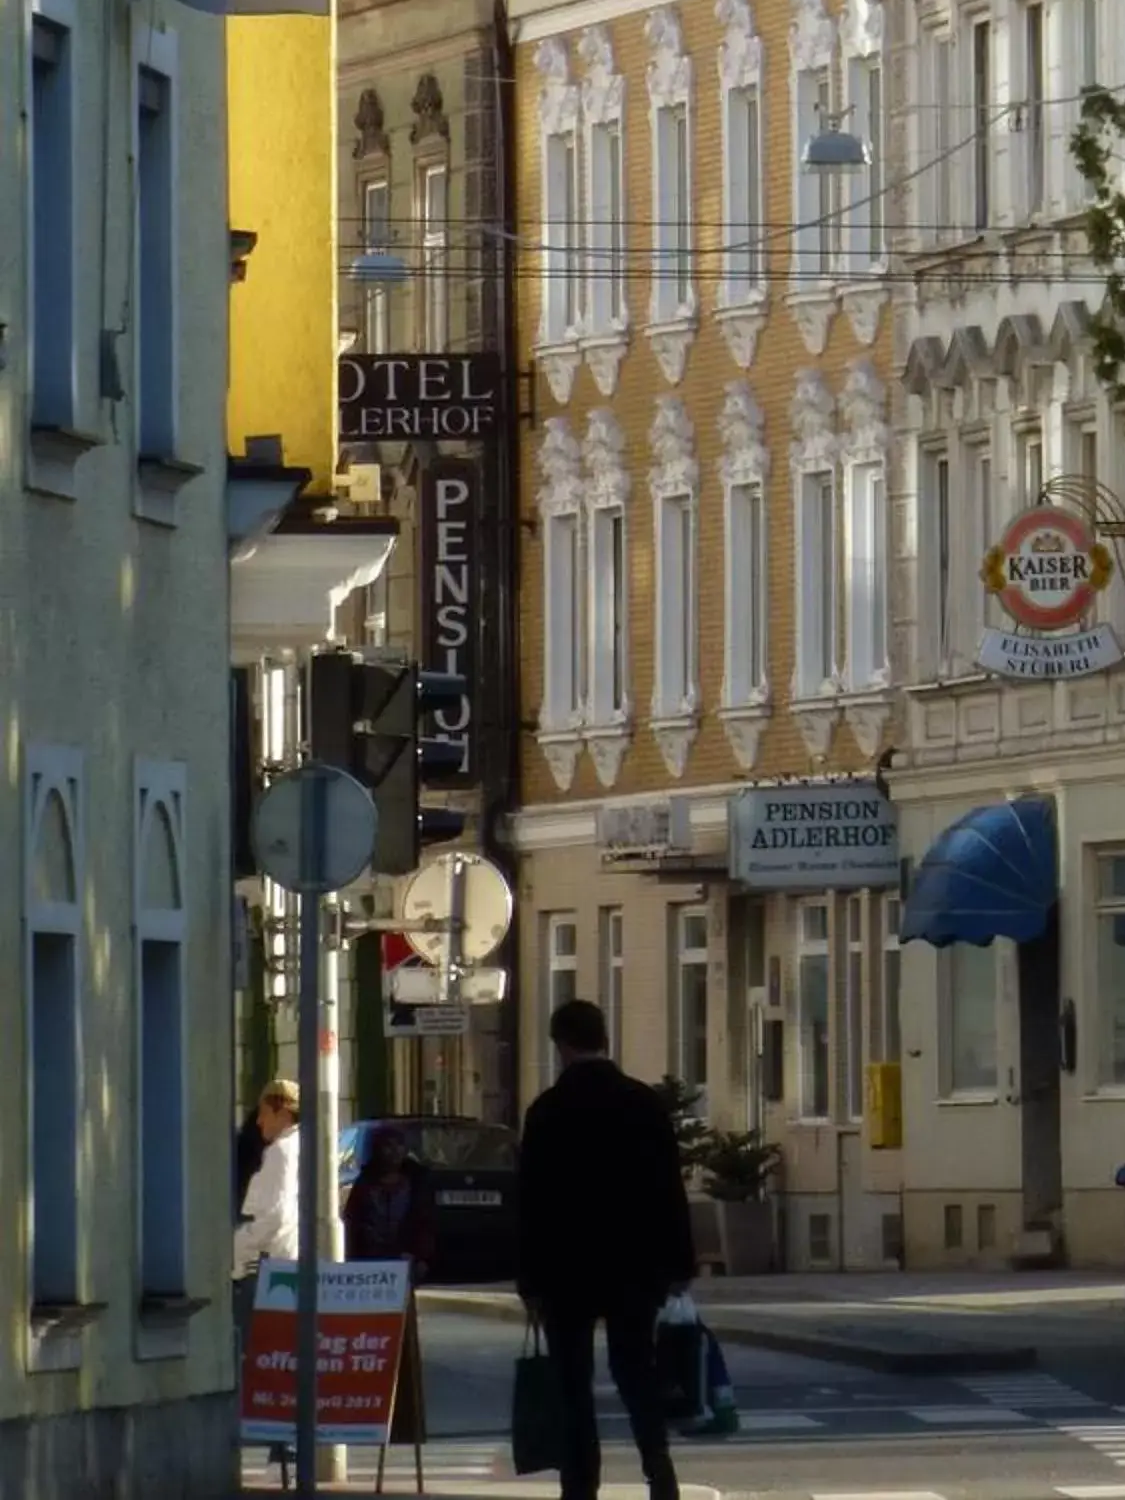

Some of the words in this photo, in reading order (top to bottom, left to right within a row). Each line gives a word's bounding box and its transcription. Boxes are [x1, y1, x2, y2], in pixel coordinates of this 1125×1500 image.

[338, 359, 494, 402] OTEL
[339, 405, 495, 435] LERHOF
[1009, 555, 1088, 581] KAISER
[1030, 577, 1071, 592] BIER
[1001, 636, 1101, 657] ELISABETH
[764, 801, 880, 822] PENSION
[750, 824, 897, 849] ADLERHOF
[320, 1270, 398, 1286] IVERSITÄT
[351, 1332, 391, 1350] der
[256, 1350, 344, 1373] offeen
[350, 1354, 388, 1373] Tür
